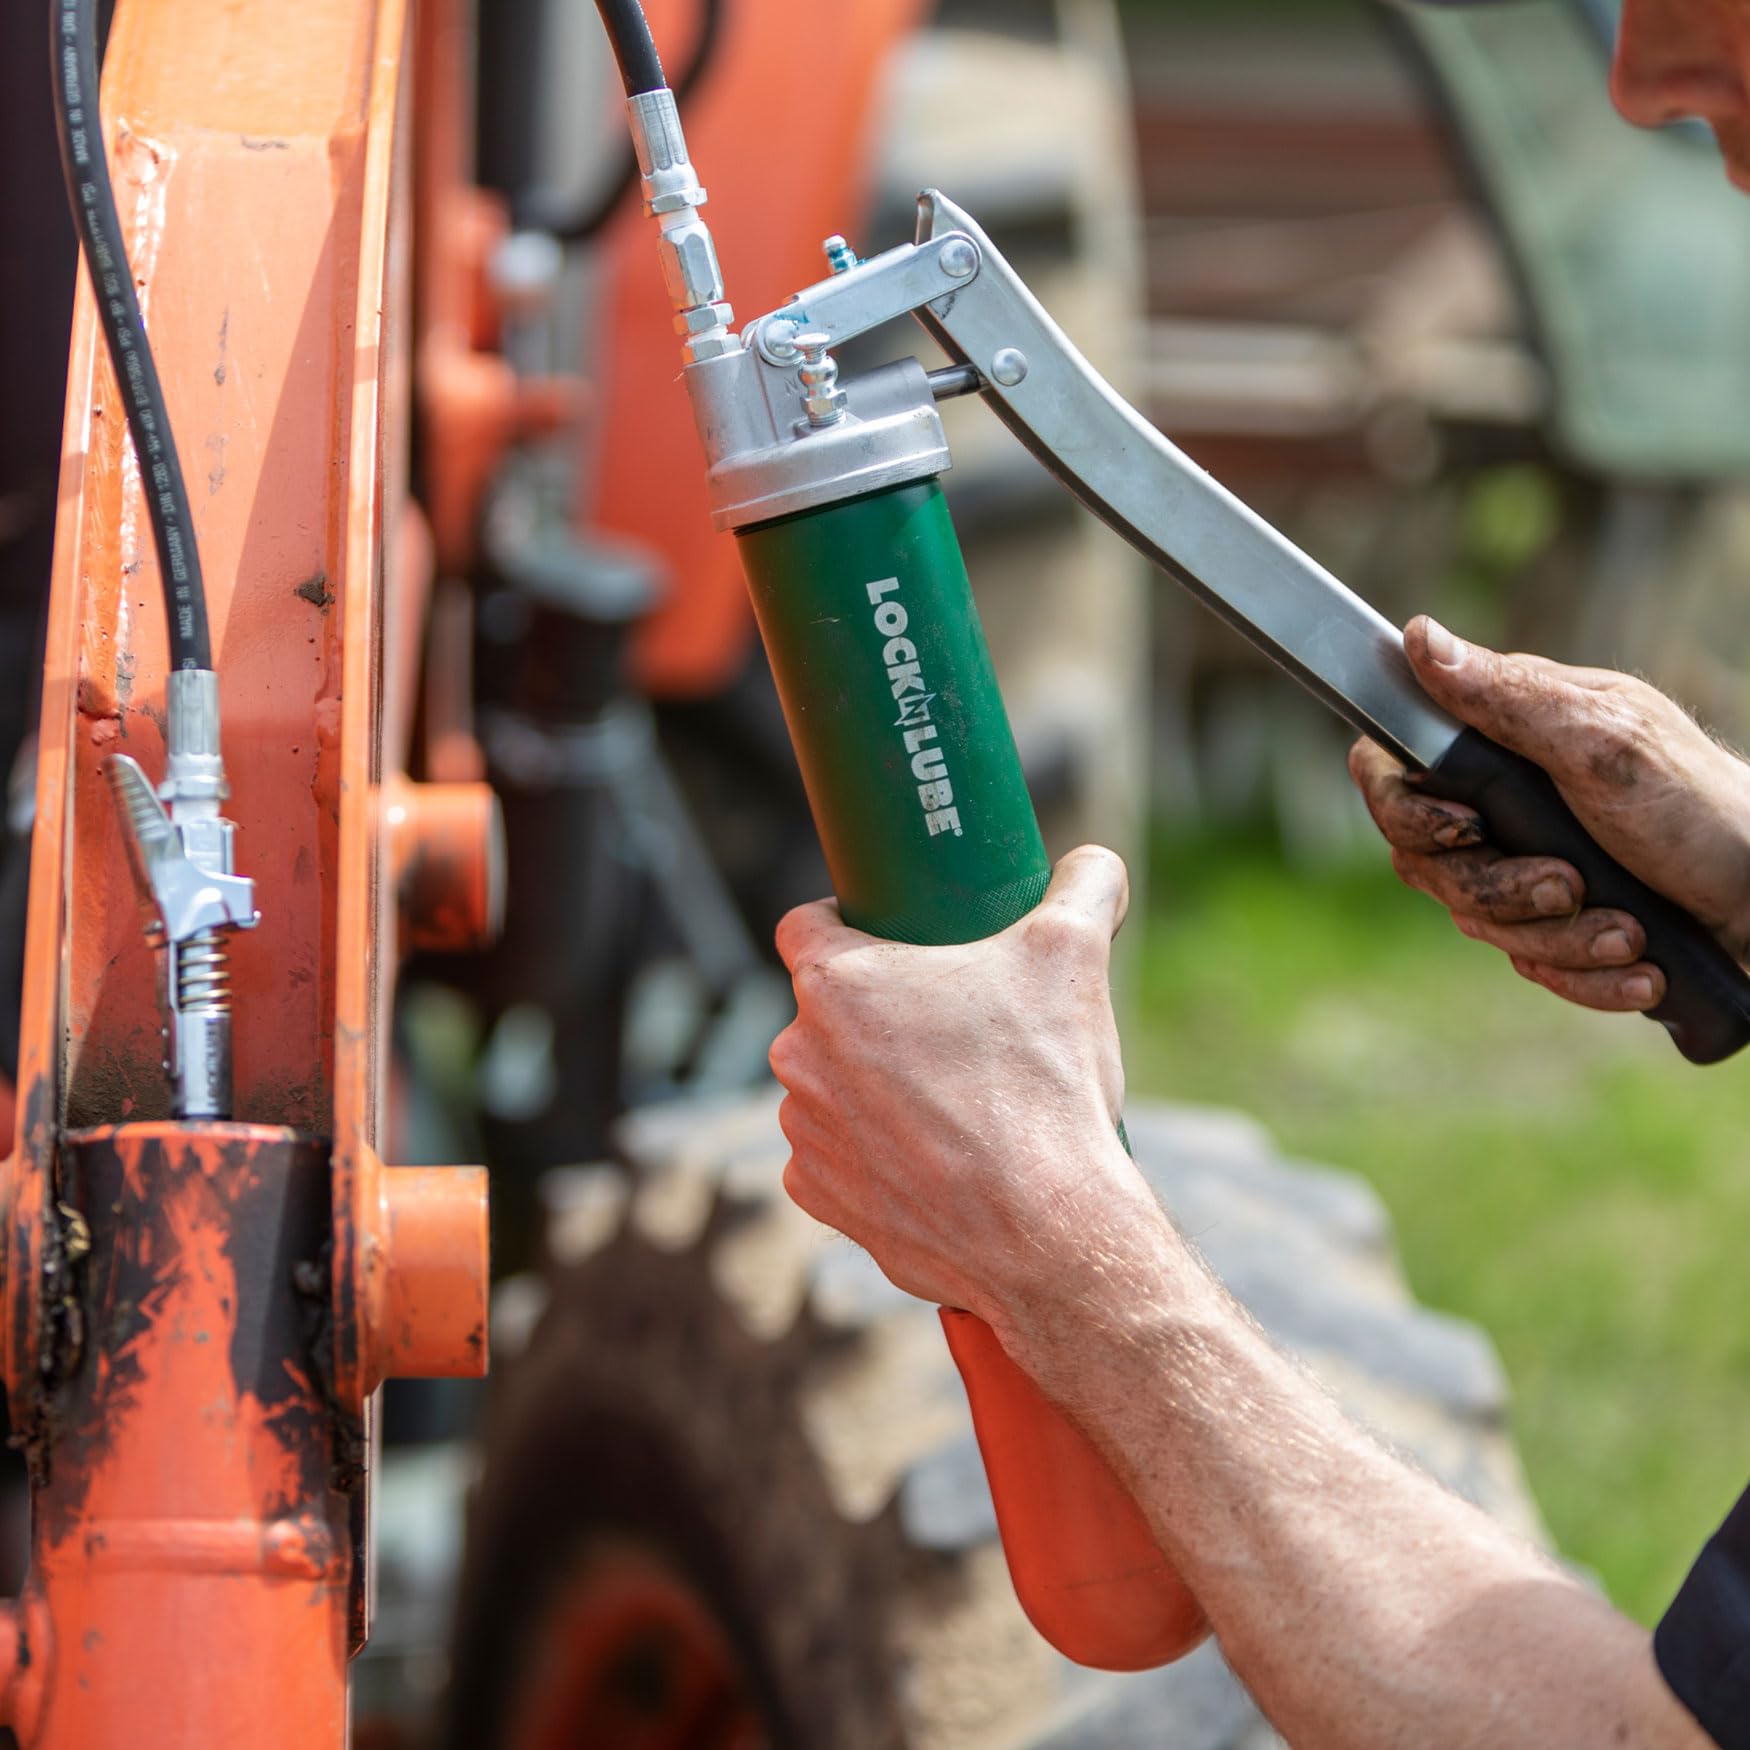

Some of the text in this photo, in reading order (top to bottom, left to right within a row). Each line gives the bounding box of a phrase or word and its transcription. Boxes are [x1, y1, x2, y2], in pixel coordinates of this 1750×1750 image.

[63, 45, 81, 105] GERMANY
[68, 108, 83, 125] IN
[70, 127, 88, 163] MADE
[159, 492, 176, 513] DIN
[165, 525, 187, 581] GERMANY
[175, 585, 191, 599] IN
[177, 604, 194, 639] MADE
